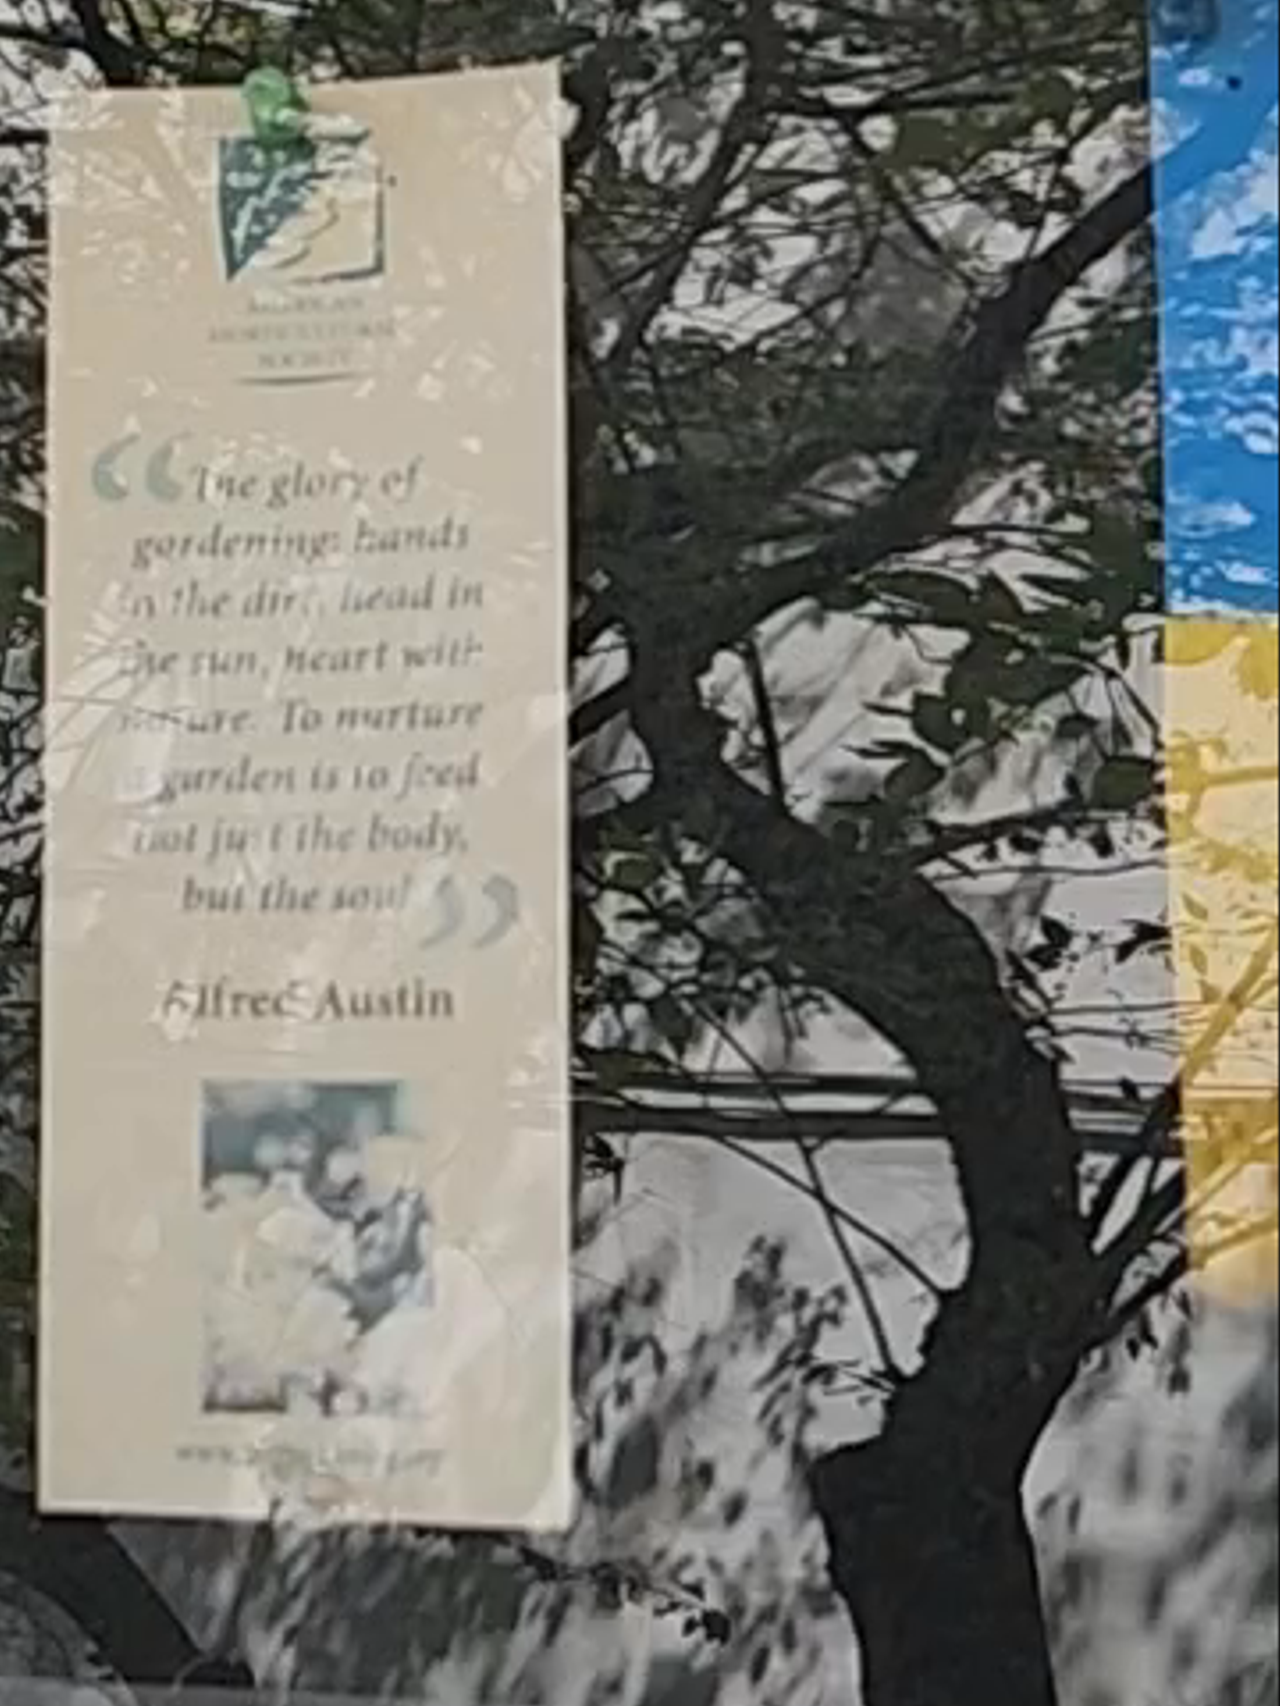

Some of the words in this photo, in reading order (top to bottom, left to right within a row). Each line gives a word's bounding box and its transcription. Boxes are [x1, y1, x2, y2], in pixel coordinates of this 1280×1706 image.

[262, 461, 371, 509] glory
[380, 453, 426, 504] of
[352, 516, 472, 556] hands
[169, 579, 231, 619] the
[339, 573, 434, 616] head
[445, 574, 487, 612] in
[188, 646, 265, 680] sun,
[282, 635, 387, 677] heart
[280, 695, 325, 736] To
[335, 697, 487, 735] nurture
[309, 755, 340, 796] is
[351, 761, 391, 794] to
[294, 813, 356, 854] the
[366, 810, 472, 861] body,
[180, 874, 248, 917] but
[260, 875, 322, 916] the
[314, 977, 456, 1022] Austin
